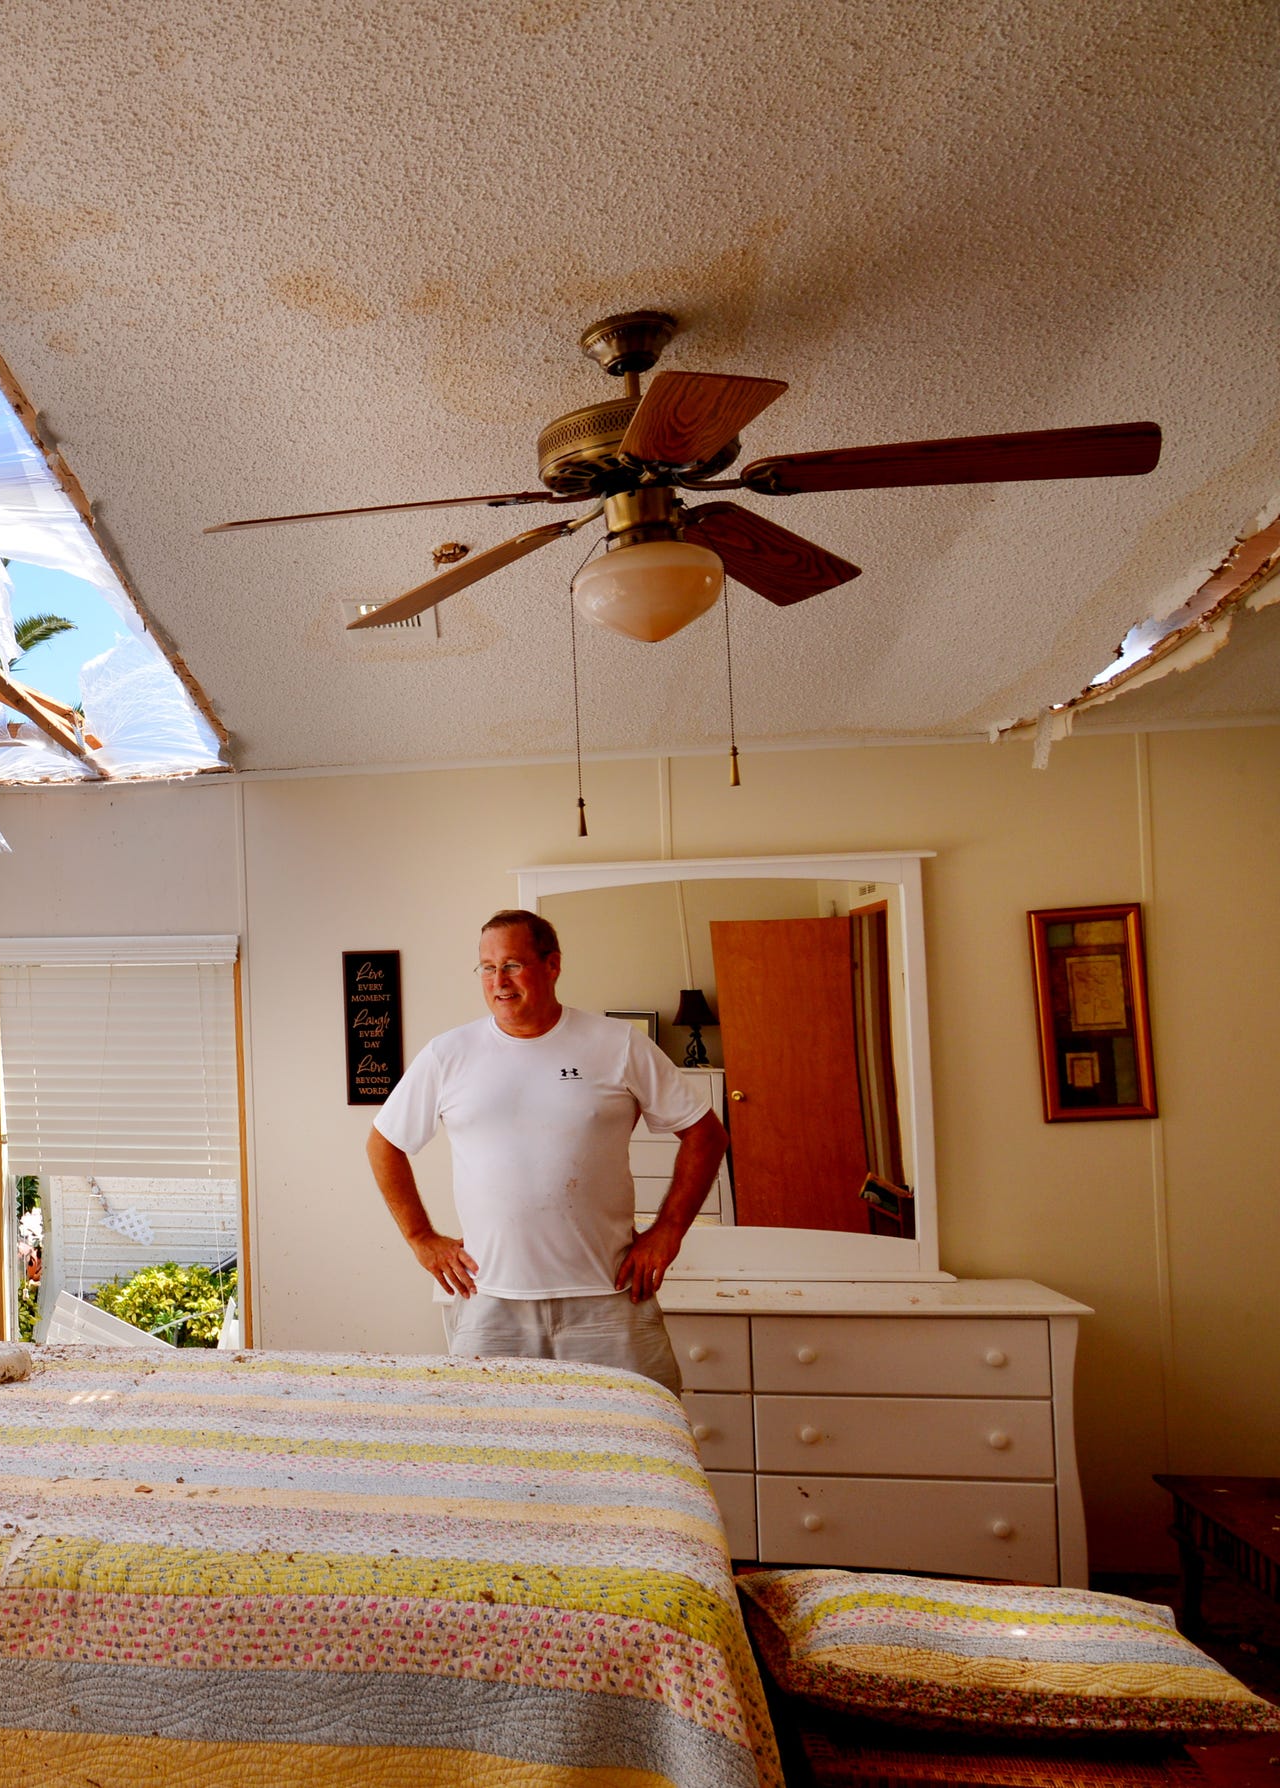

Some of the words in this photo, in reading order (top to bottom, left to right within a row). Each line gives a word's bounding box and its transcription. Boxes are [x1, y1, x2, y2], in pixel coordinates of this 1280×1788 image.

[356, 961, 384, 981] Live
[358, 983, 383, 991] EVERY
[351, 994, 391, 1002] MOMENT
[353, 1008, 391, 1033] Laugh
[359, 1030, 384, 1038] EVERY
[357, 1054, 388, 1074] Love
[355, 1076, 391, 1084] BEYOND
[358, 1087, 389, 1095] WORDS
